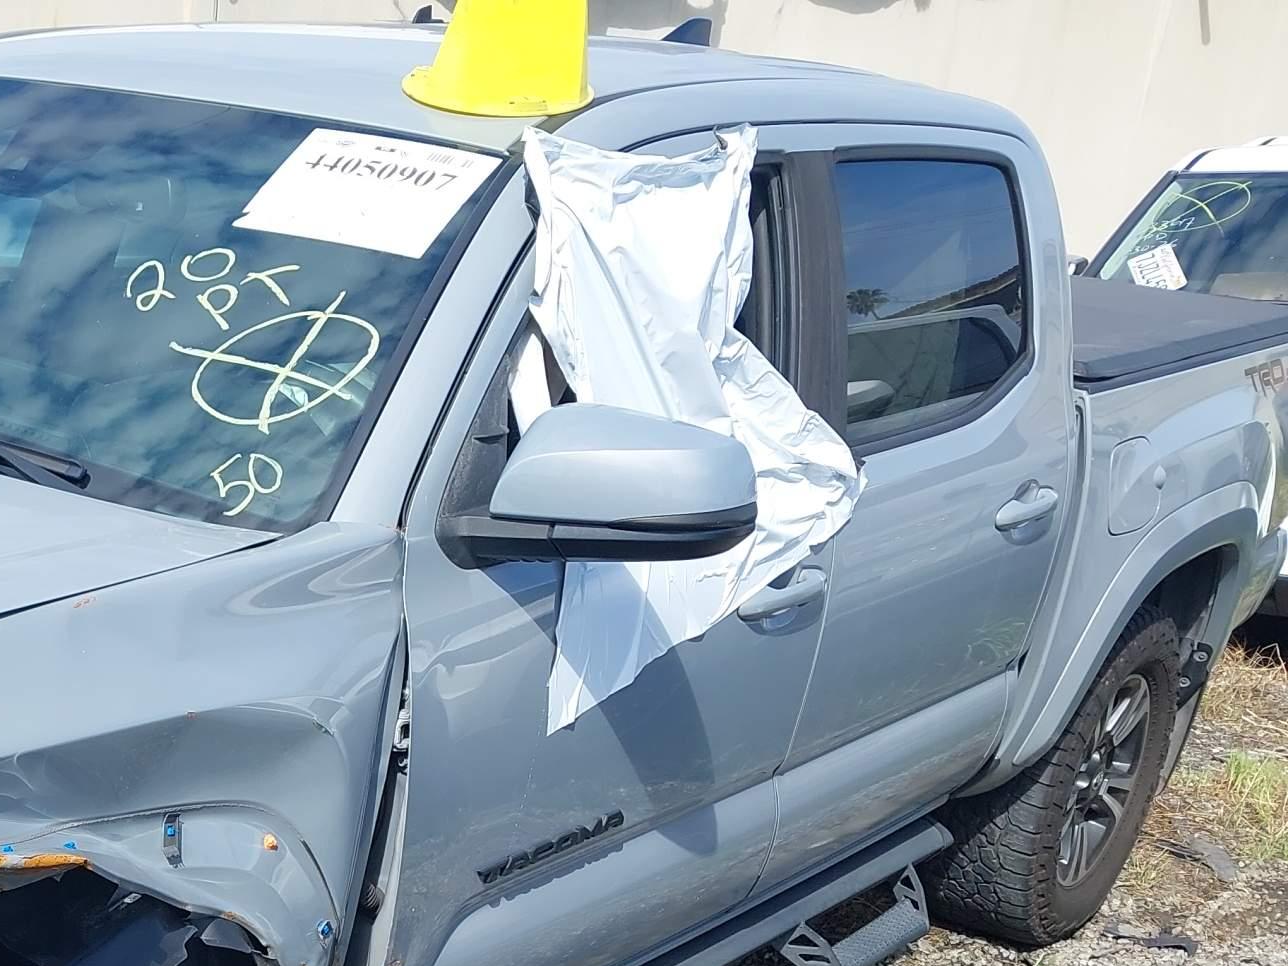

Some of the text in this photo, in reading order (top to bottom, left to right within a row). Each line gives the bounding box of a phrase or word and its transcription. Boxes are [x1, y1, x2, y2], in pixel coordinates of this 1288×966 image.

[305, 153, 458, 191] 44050907
[125, 247, 236, 312] 20
[1244, 358, 1285, 398] TRD
[211, 452, 284, 516] 50
[477, 808, 625, 885] TACOMA
